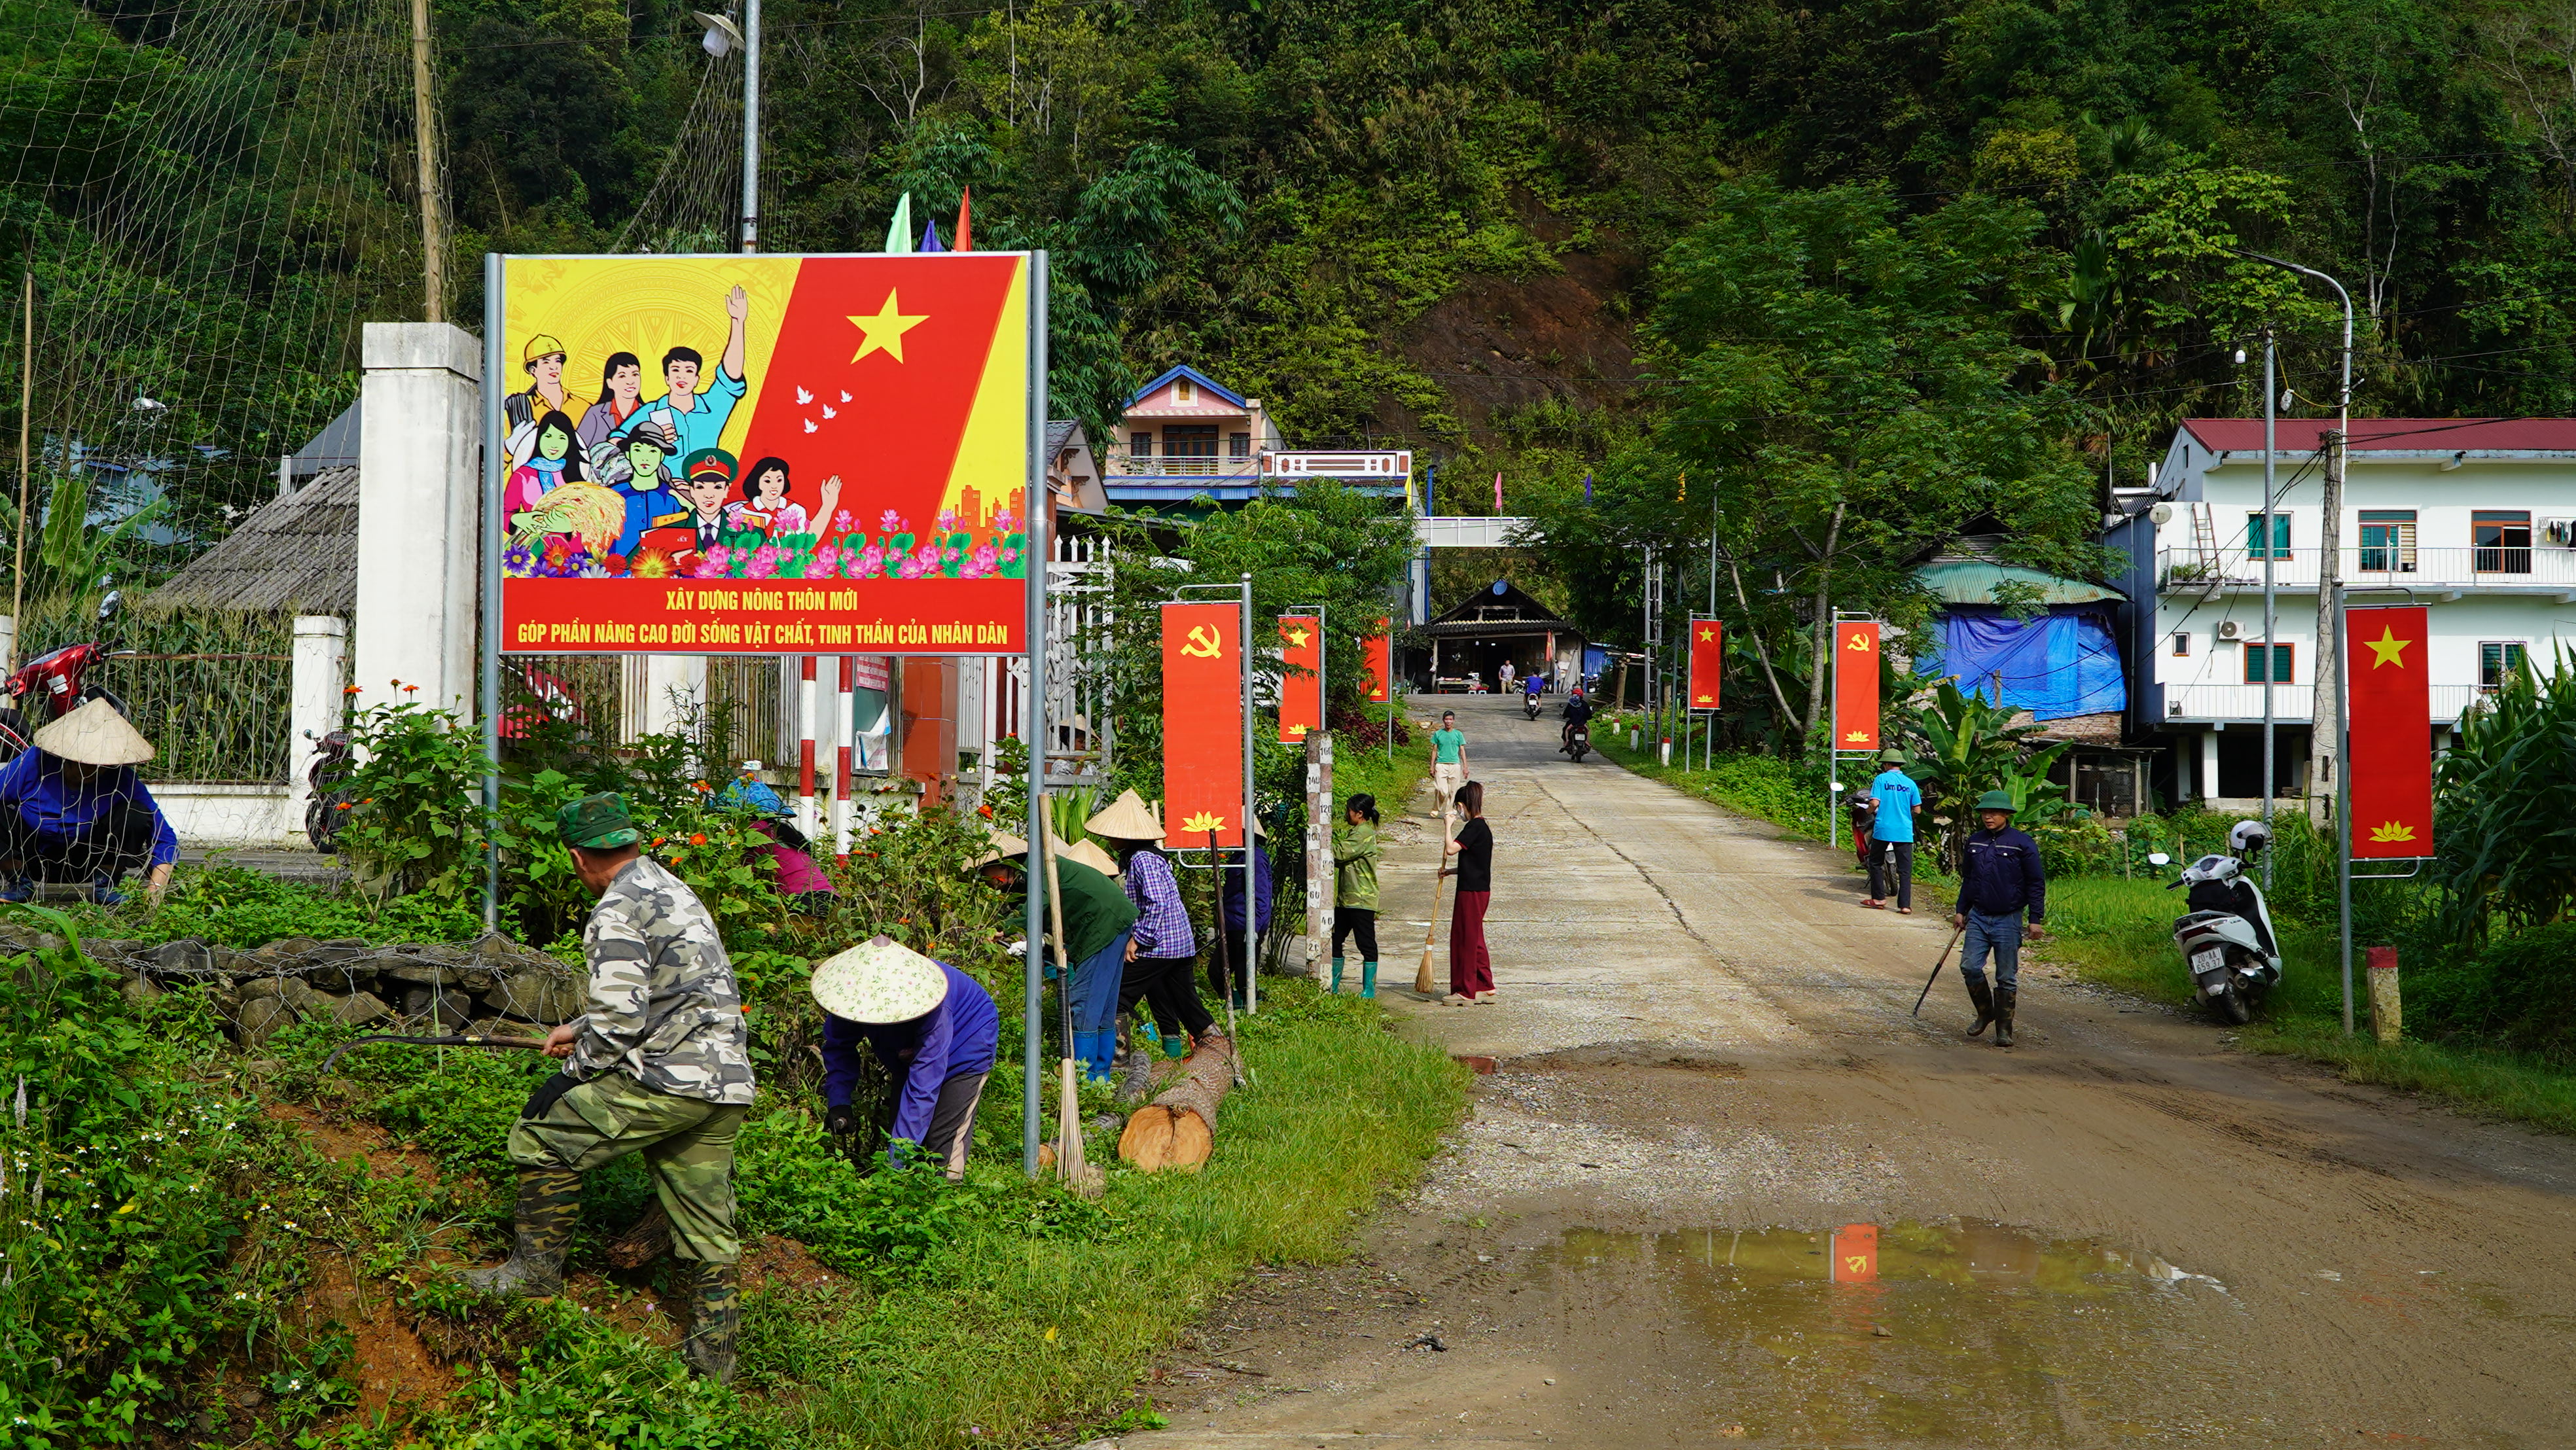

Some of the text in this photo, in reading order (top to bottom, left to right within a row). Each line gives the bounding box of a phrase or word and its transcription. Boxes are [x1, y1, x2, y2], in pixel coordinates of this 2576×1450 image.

[666, 587, 858, 614] XÂY DỰNG NÔNG THÔN MỚI
[518, 617, 1008, 648] GÓP PHẦN NÂNG CAO ĐỜI SỐNG VẬT CHẤT, TINH THẦN CỦA NHÂN DÂN
[1322, 917, 1333, 925] 40
[2196, 950, 2217, 964] 20-AA
